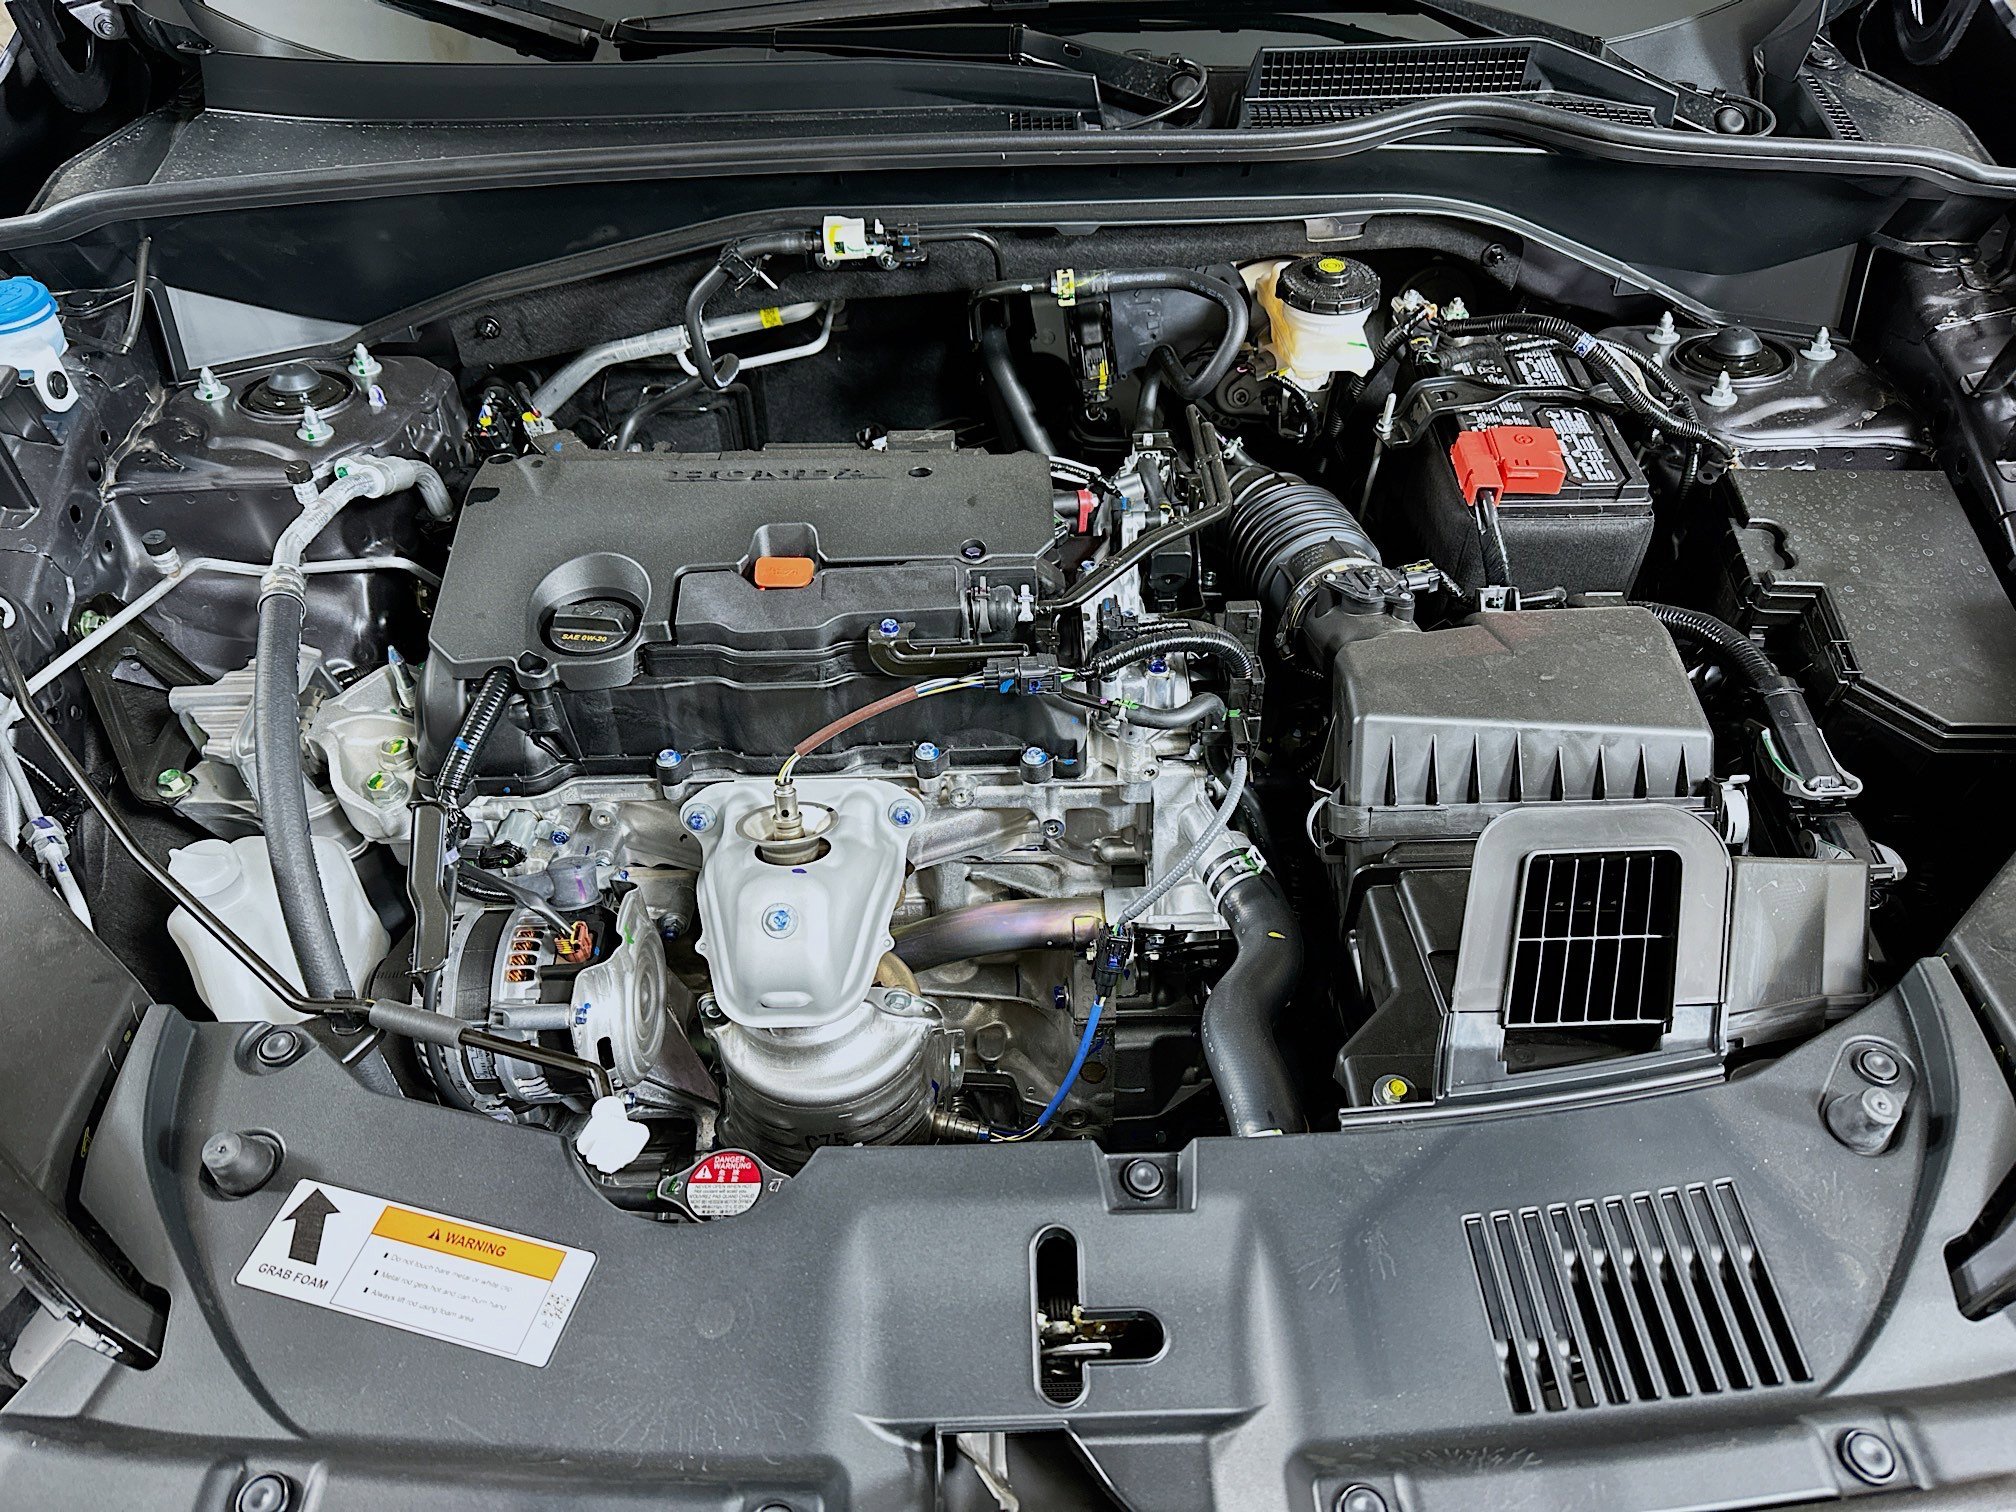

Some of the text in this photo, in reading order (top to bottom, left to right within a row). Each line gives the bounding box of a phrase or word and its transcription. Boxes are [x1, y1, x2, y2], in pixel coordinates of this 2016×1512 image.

[561, 633, 608, 643] SAE 0W-20
[713, 1162, 752, 1170] WARNUNG
[445, 1232, 507, 1258] WARNING
[258, 1263, 329, 1290] GRAB FOAM
